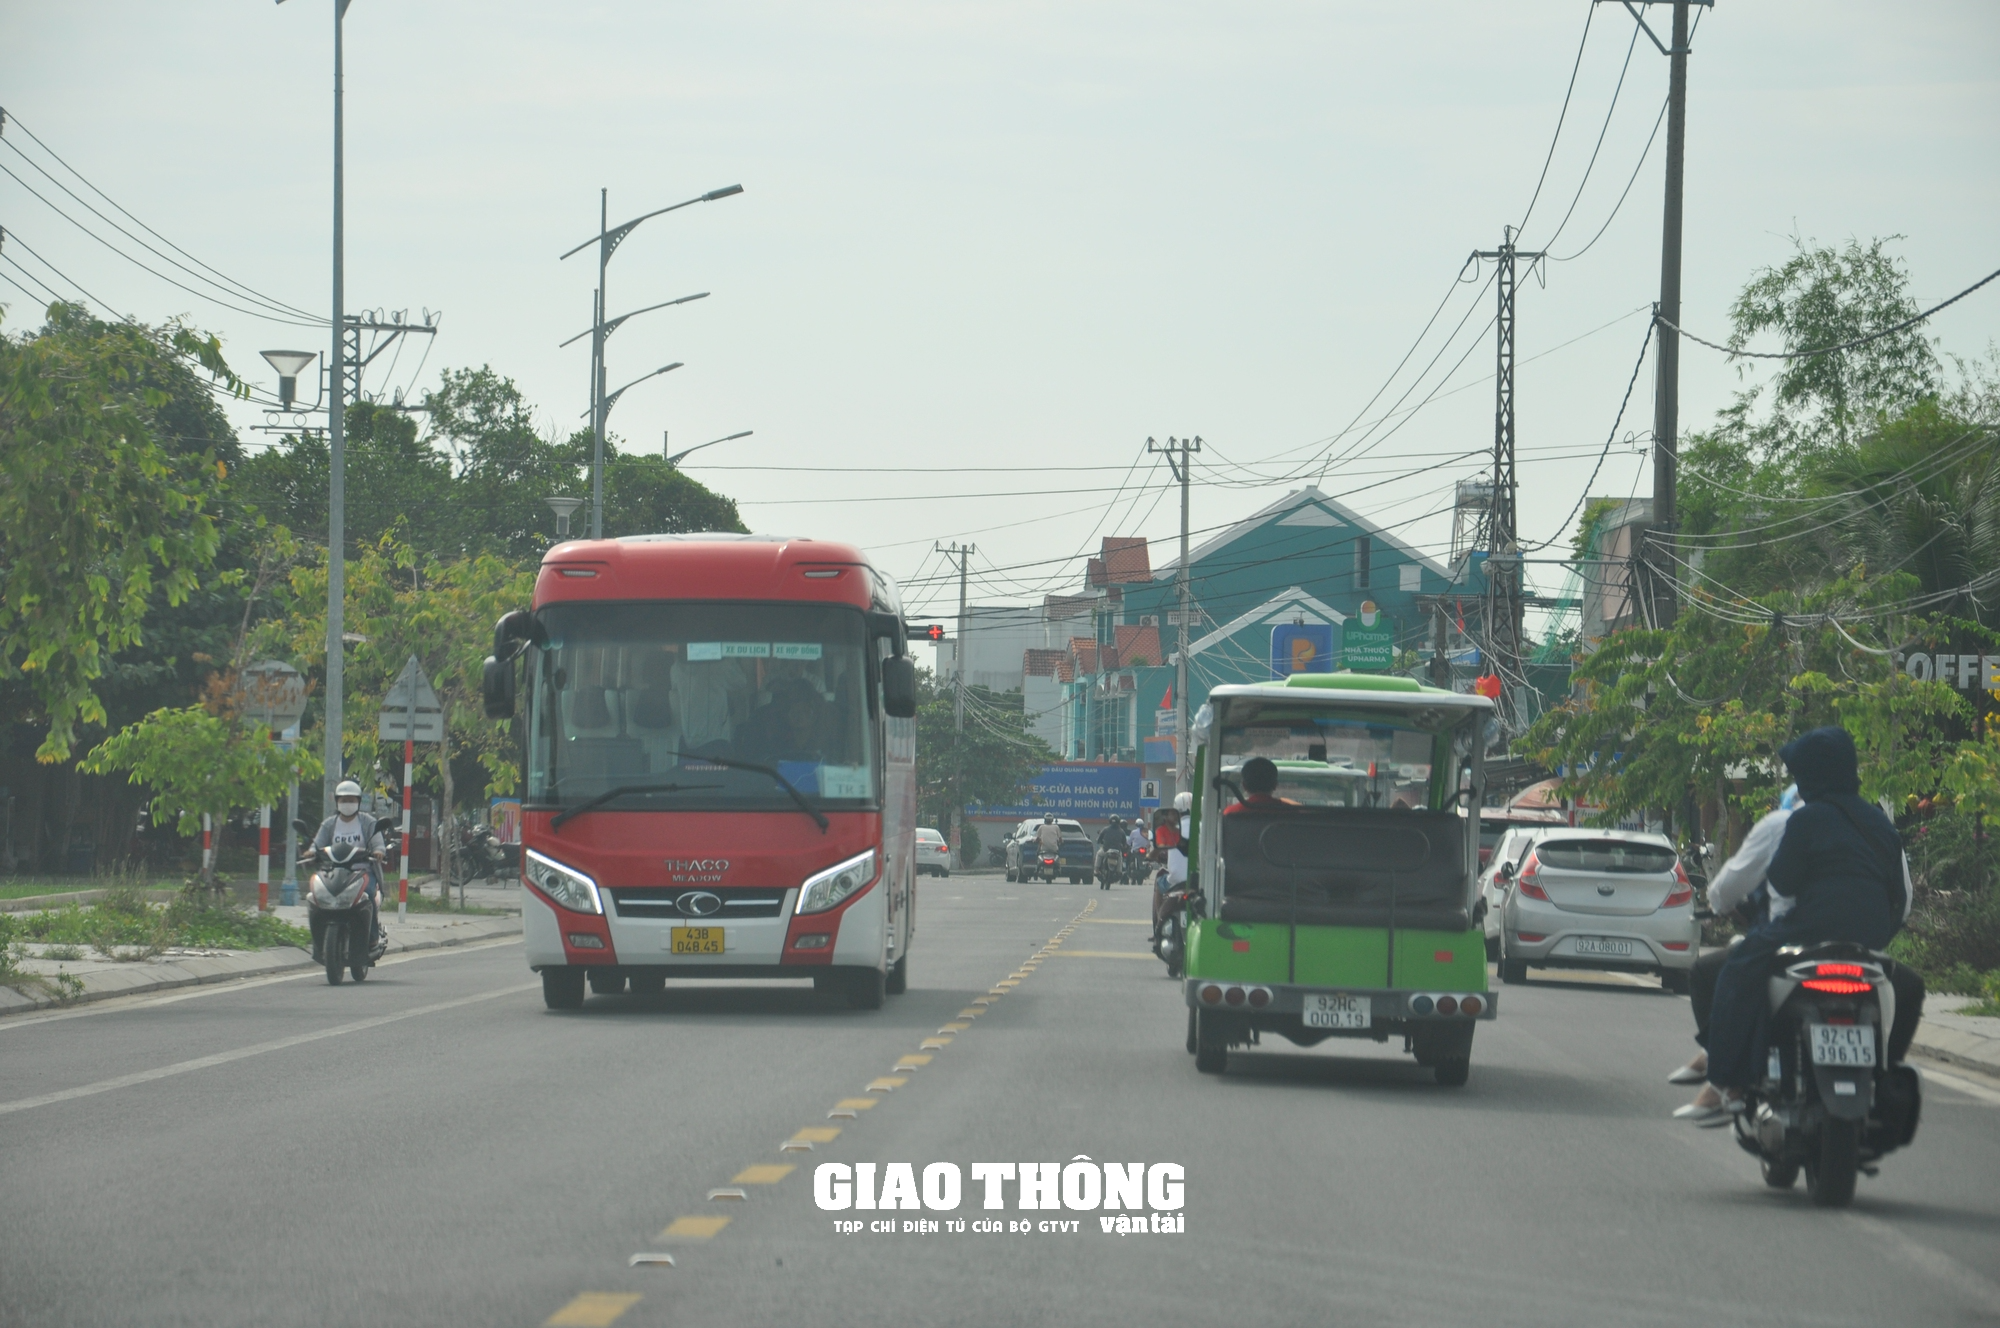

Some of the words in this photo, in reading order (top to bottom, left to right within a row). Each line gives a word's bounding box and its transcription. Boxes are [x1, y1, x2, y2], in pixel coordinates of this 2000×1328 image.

[726, 646, 735, 654] XE
[775, 646, 784, 654] XE
[1344, 646, 1362, 654] NHÀ
[1107, 786, 1120, 795] 61
[1102, 799, 1118, 811] HỘI
[1120, 801, 1133, 809] AN
[335, 834, 361, 844] CREW
[664, 859, 730, 872] THACO
[686, 928, 709, 940] 43B
[677, 941, 719, 952] 048.45
[1817, 1045, 1872, 1063] 396.15
